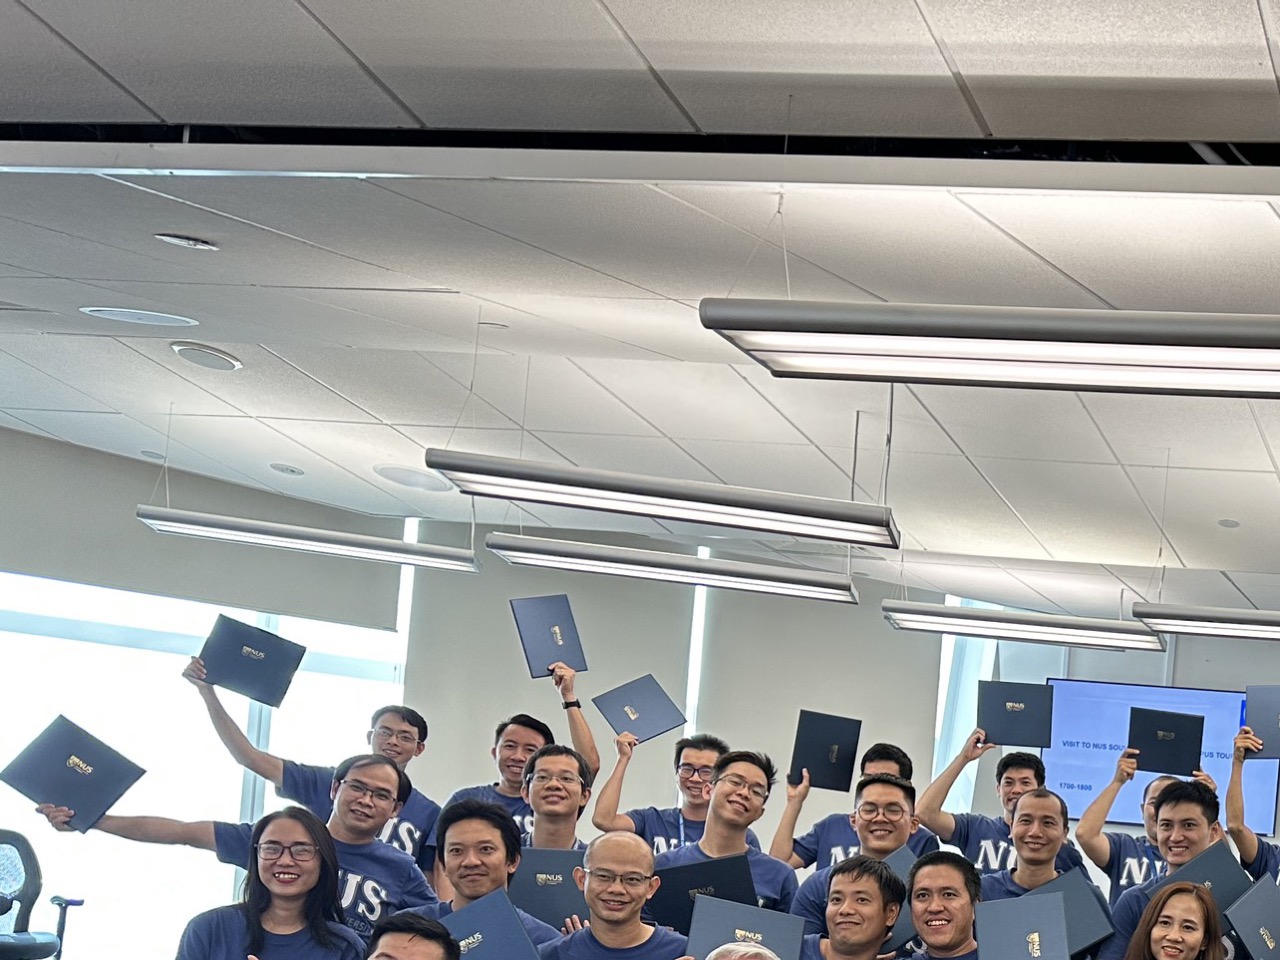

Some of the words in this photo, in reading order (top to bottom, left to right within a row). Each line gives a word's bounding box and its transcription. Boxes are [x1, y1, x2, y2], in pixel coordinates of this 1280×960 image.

[1062, 740, 1080, 748] VISIT
[1082, 741, 1091, 749] TO
[1092, 742, 1107, 750] NUS
[465, 932, 482, 946] NUS
[746, 931, 762, 941] NUS
